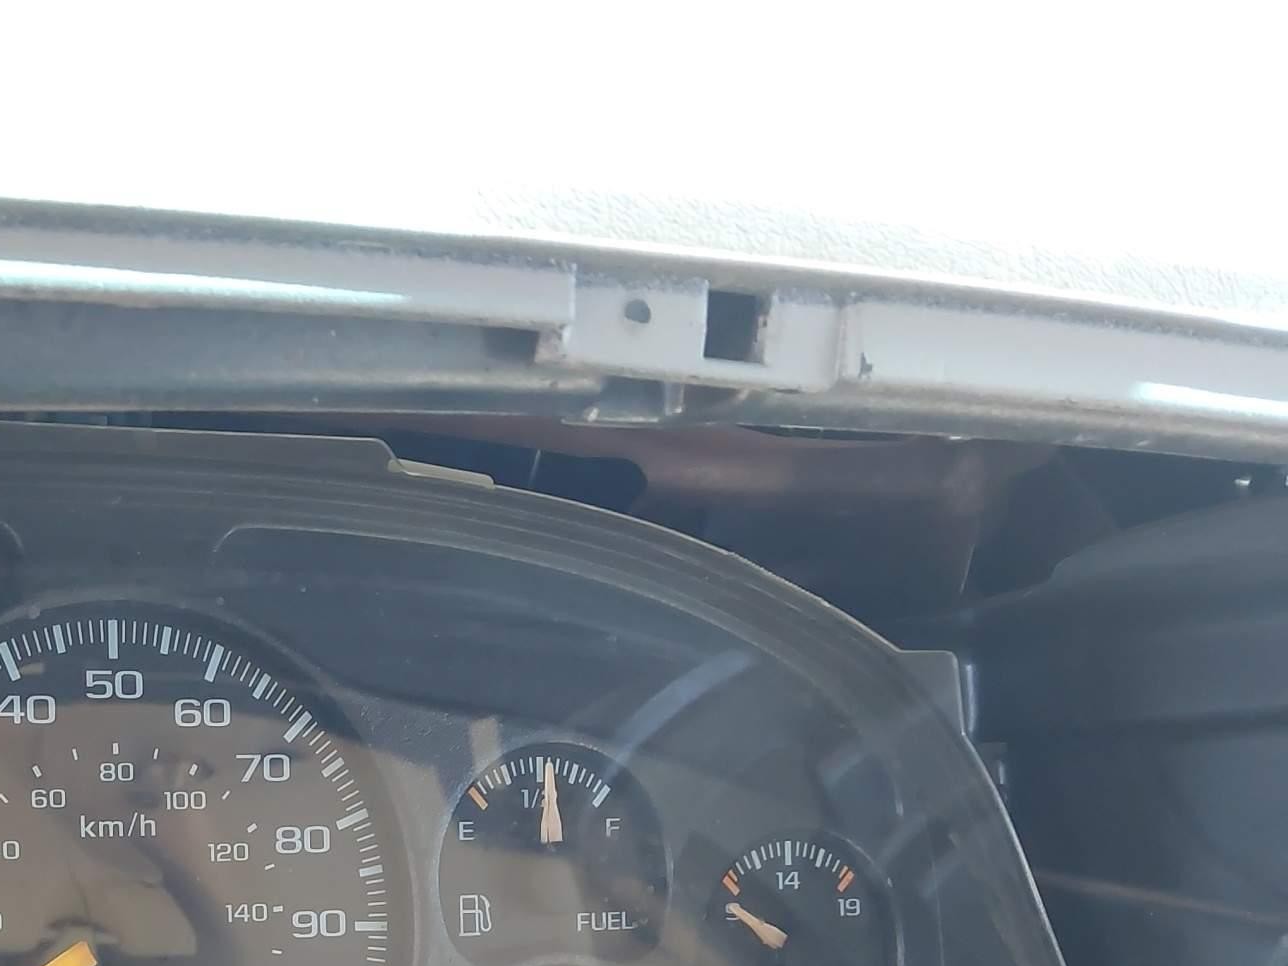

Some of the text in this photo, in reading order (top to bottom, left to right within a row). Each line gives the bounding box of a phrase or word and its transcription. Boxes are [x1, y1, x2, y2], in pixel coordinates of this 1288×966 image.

[85, 670, 143, 699] 50
[174, 698, 231, 727] 60
[99, 762, 134, 782] 80
[236, 754, 291, 783] 70
[31, 789, 66, 809] 60
[164, 791, 207, 810] 100
[79, 813, 157, 838] km/h
[459, 822, 475, 841] E
[606, 818, 621, 837] F
[275, 825, 331, 854] 80
[208, 842, 249, 862] 120
[776, 871, 800, 890] 14
[225, 903, 268, 923] 140
[837, 899, 861, 917] 19
[291, 909, 347, 938] 90
[577, 912, 633, 931] FUEL
